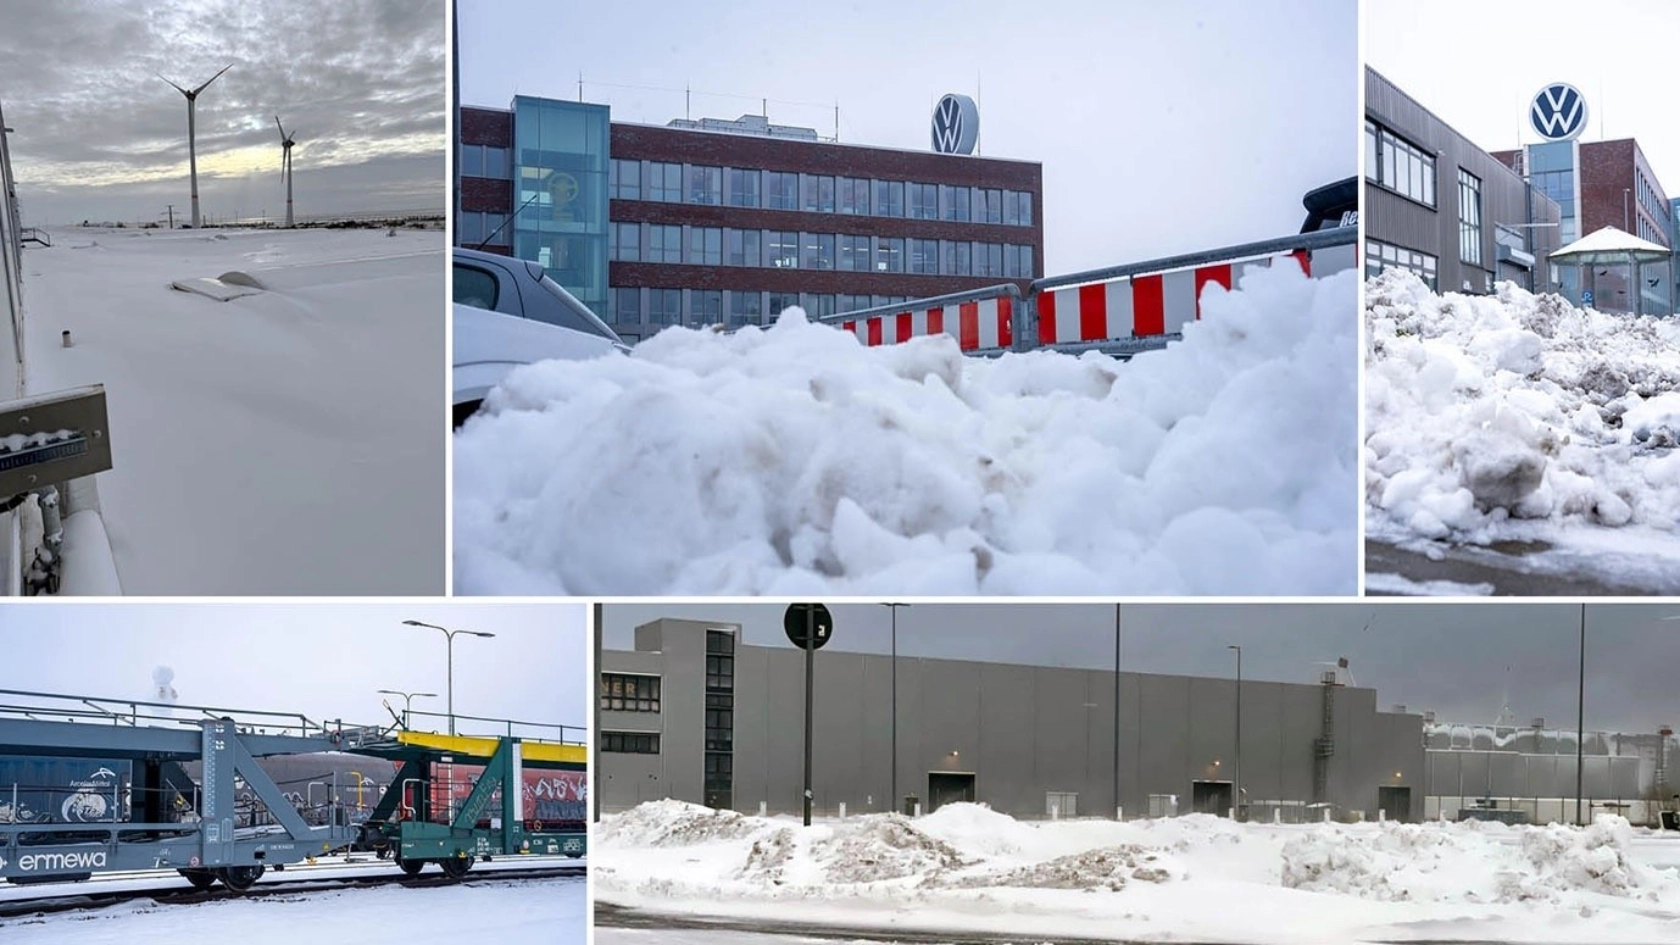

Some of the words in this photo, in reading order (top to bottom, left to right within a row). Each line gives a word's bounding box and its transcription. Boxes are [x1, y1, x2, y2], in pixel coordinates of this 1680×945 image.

[932, 94, 963, 153] VW
[1531, 83, 1585, 140] VW
[19, 851, 107, 871] ermewa
